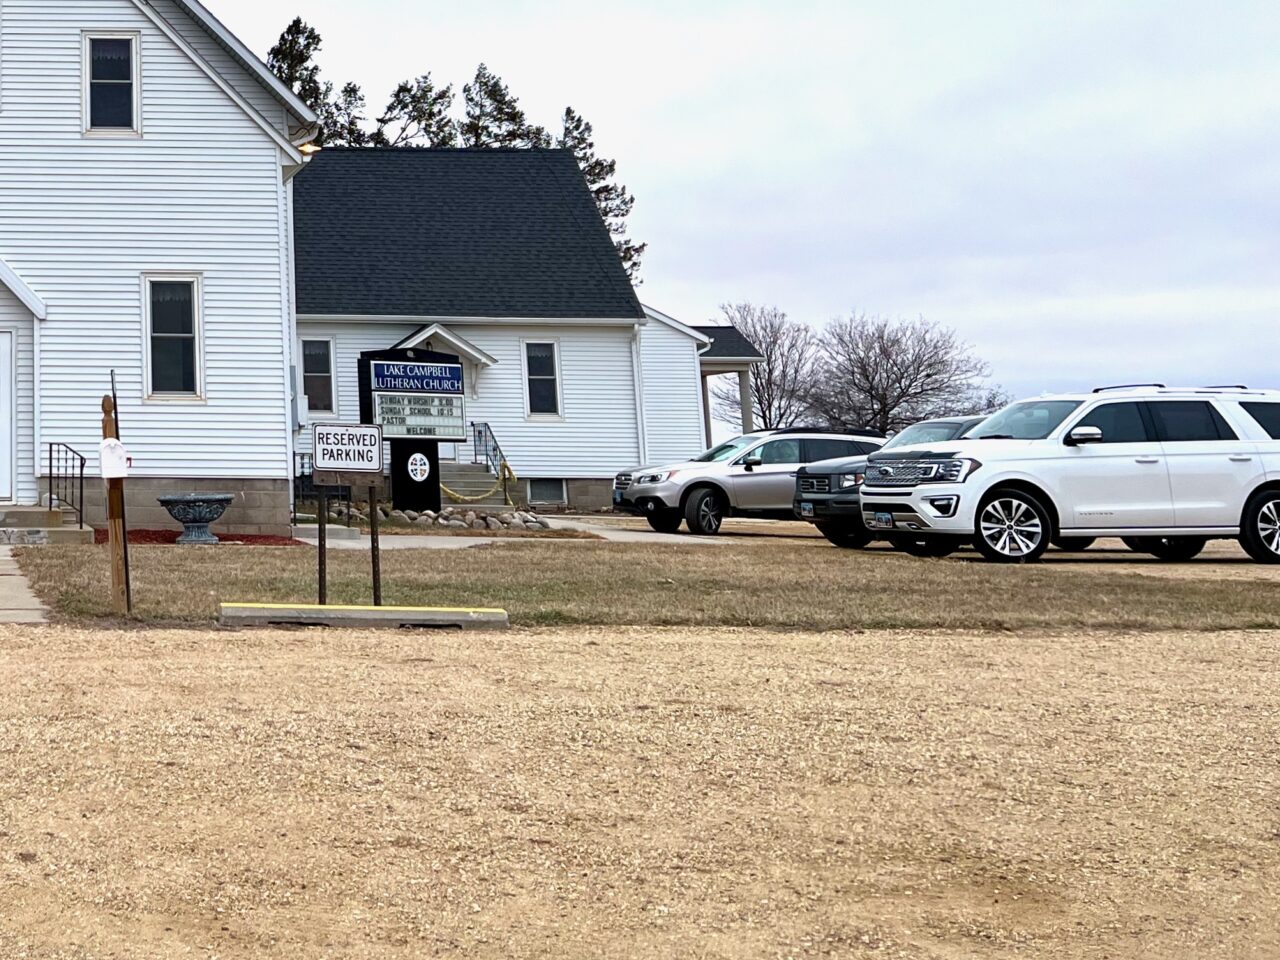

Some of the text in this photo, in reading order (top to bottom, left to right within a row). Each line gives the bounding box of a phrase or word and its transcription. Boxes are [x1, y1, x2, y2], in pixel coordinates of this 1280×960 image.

[384, 365, 451, 378] LAKE CAMPBELL
[375, 377, 462, 391] LUTHERAN CHURCH
[379, 396, 405, 406] SUNDAY
[380, 406, 406, 416] SUNDAY
[409, 407, 433, 416] SCHOOL
[381, 416, 407, 425] PASTOR
[406, 427, 437, 436] WELCOME
[317, 432, 377, 447] RESERVED
[322, 448, 373, 463] PARKING
